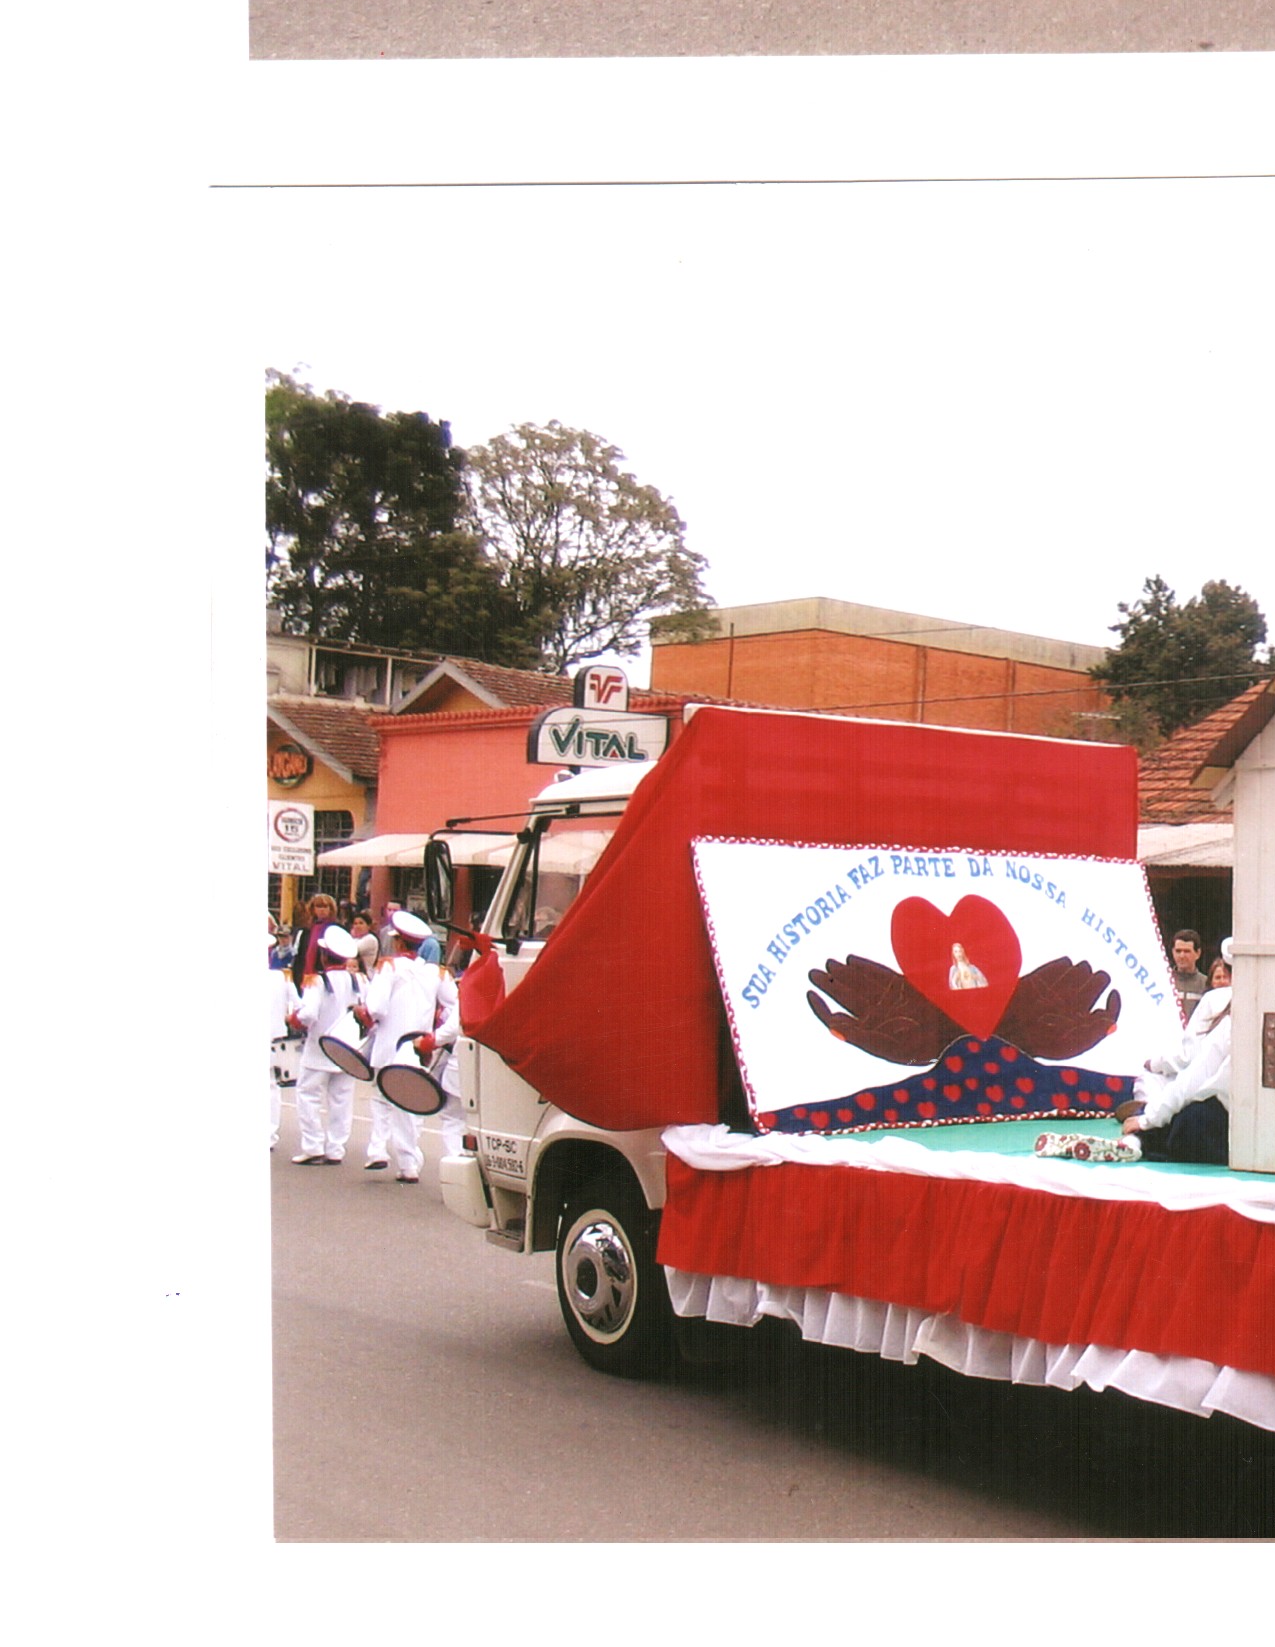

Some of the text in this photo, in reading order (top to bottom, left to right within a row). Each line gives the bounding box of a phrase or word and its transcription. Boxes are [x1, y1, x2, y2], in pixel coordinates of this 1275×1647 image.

[550, 715, 648, 762] VITAL
[272, 861, 309, 873] VITAL
[741, 854, 1165, 1010] SUA HISTORIA FAZ PARTE DA NOSSA HISTORIA
